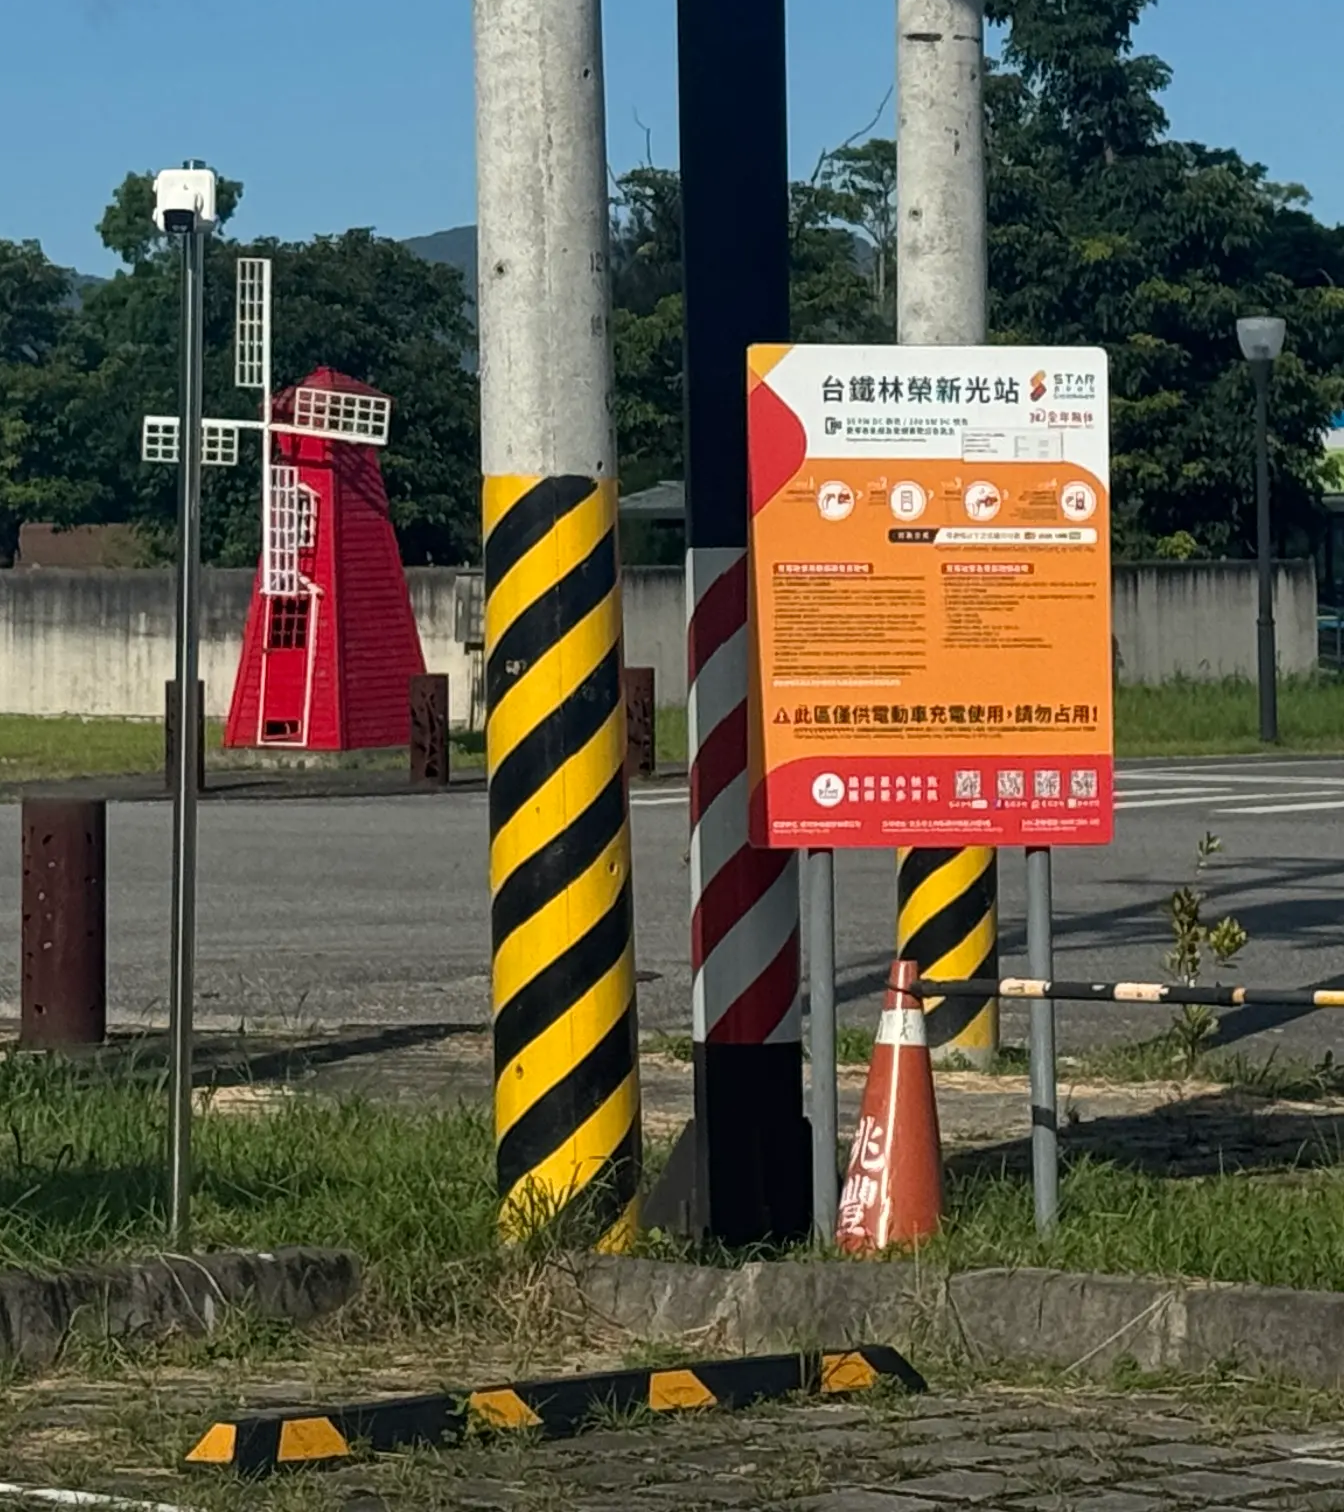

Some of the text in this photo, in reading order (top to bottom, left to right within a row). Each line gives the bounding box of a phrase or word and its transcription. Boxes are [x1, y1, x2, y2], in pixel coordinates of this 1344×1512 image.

[822, 374, 1020, 404] 台鐵林榮新光站
[1053, 373, 1095, 385] STAR
